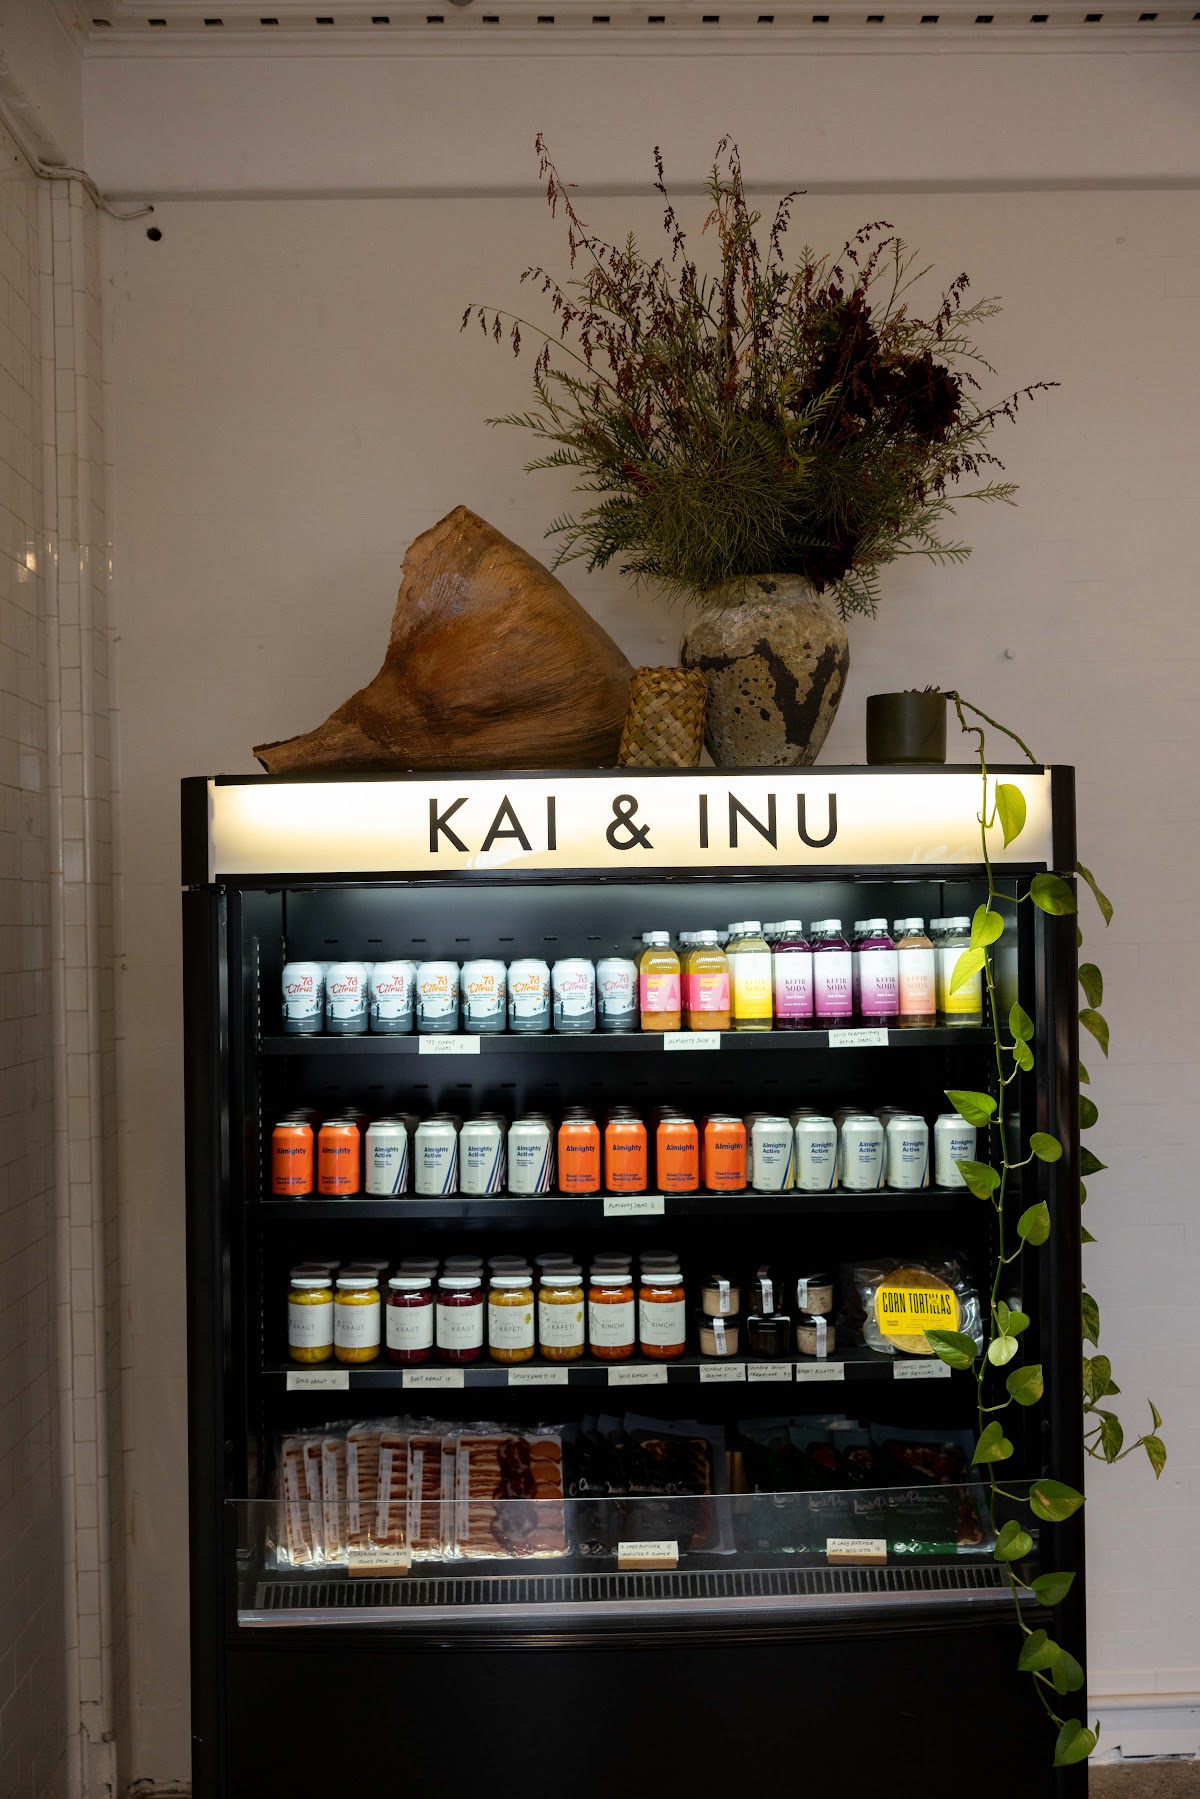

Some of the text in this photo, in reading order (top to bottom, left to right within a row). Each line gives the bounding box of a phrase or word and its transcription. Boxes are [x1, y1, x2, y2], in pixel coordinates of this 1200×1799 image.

[429, 791, 838, 853] KAI & INU
[286, 983, 313, 994] Citrus
[330, 983, 358, 994] Citrus
[376, 983, 404, 994] Citrus
[420, 983, 448, 994] Citrus
[467, 982, 495, 993] Citrus
[513, 982, 540, 993] Citrus
[560, 981, 588, 992] Citrus
[602, 980, 629, 991] Citrus
[277, 1147, 306, 1155] Almighty
[322, 1147, 350, 1155] Almighty
[566, 1144, 595, 1152] Almighty
[613, 1144, 641, 1152] Almighty
[666, 1144, 694, 1152] Almighty
[882, 1292, 952, 1314] CORN TORTILLAS
